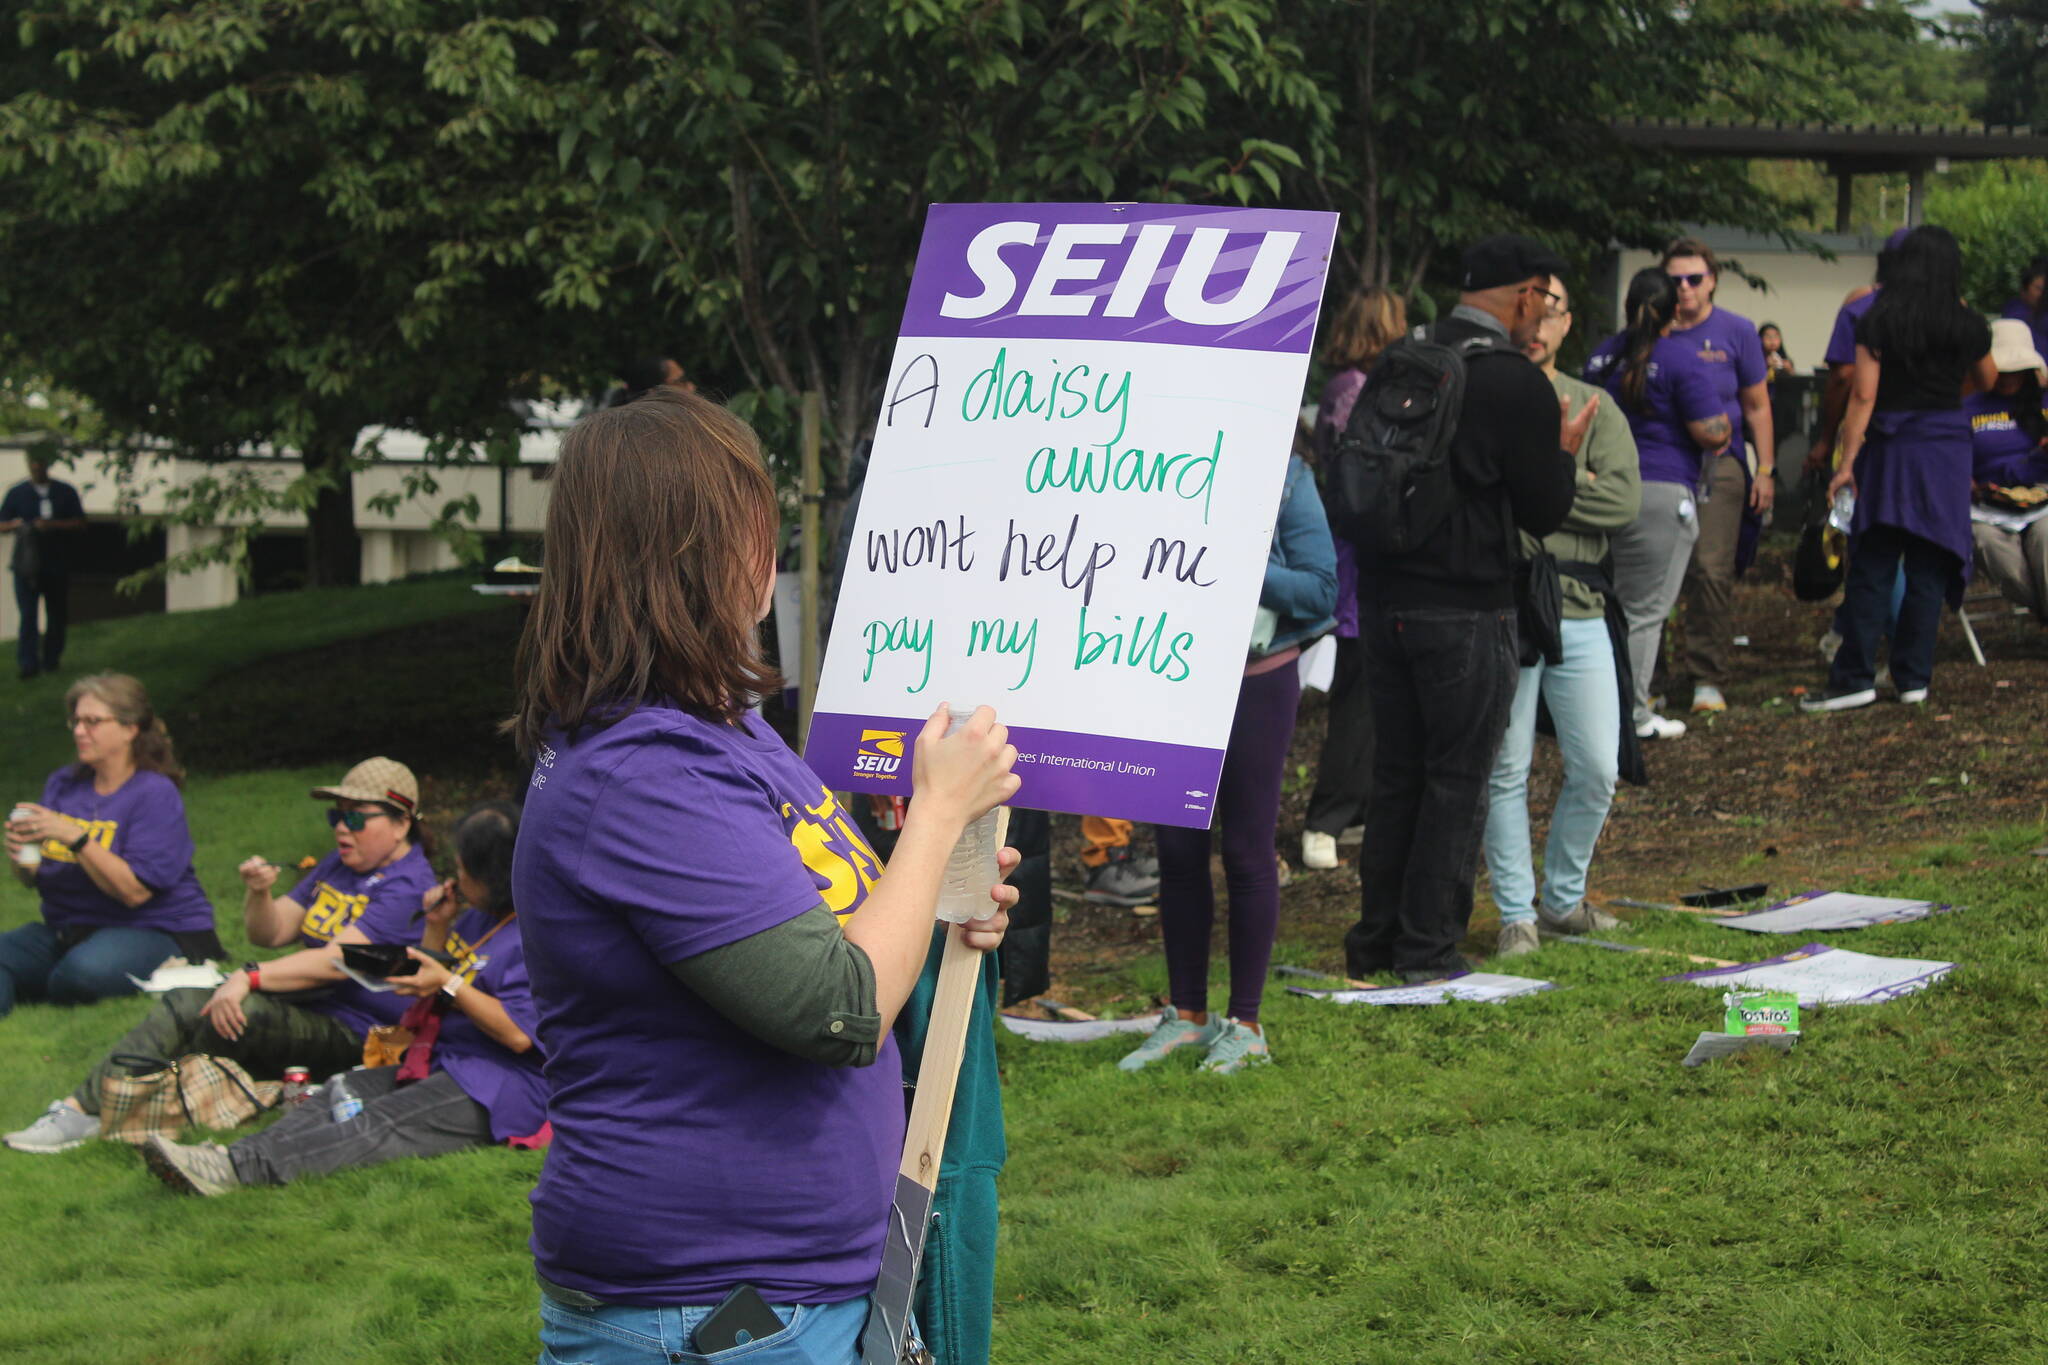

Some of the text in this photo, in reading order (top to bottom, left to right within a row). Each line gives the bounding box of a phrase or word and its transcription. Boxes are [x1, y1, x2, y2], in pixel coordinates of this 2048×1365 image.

[939, 221, 1302, 326] SEIU
[887, 347, 1132, 447] A daisy
[1025, 430, 1224, 524] award
[867, 514, 975, 574] wont
[1000, 514, 1115, 606] help
[863, 607, 1194, 693] pay my bills
[853, 755, 901, 772] SEIU
[853, 771, 875, 779] Stronger
[1017, 752, 1156, 777] ees International Union
